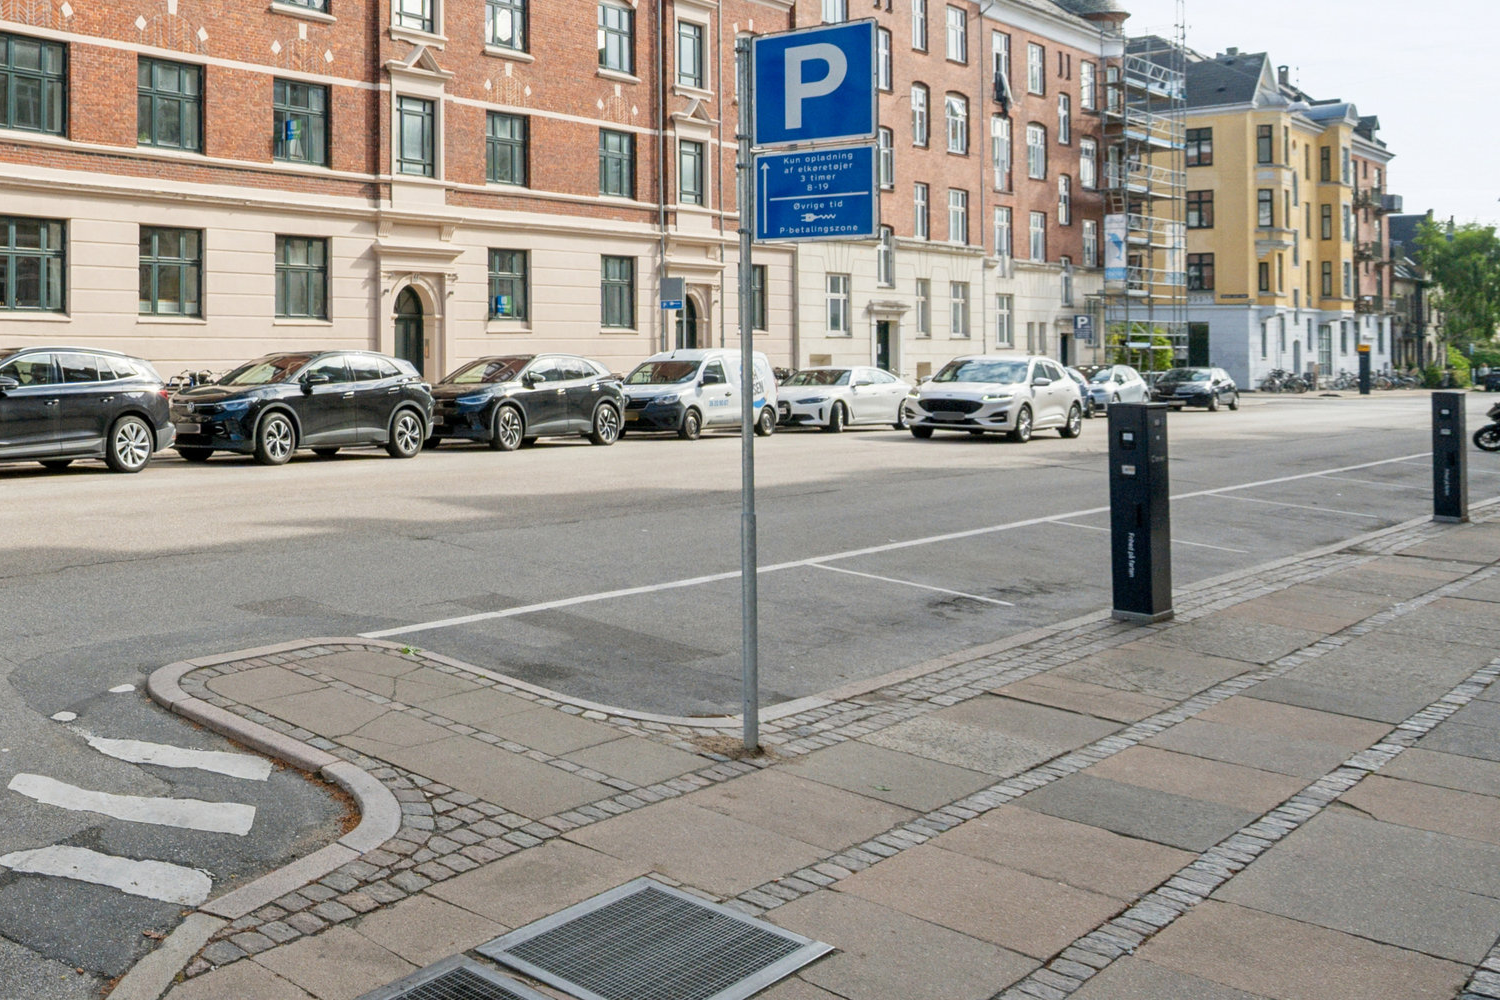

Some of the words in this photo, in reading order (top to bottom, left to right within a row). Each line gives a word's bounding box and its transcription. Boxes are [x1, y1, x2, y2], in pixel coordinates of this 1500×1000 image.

[784, 43, 847, 130] P
[805, 153, 853, 163] opladning
[784, 166, 794, 174] af
[798, 163, 853, 173] elkøretøjer
[806, 183, 829, 191] 8-19
[793, 202, 824, 210] Øvrige
[829, 200, 843, 208] tid
[780, 225, 858, 234] P-betalingszone
[1077, 316, 1088, 328] P
